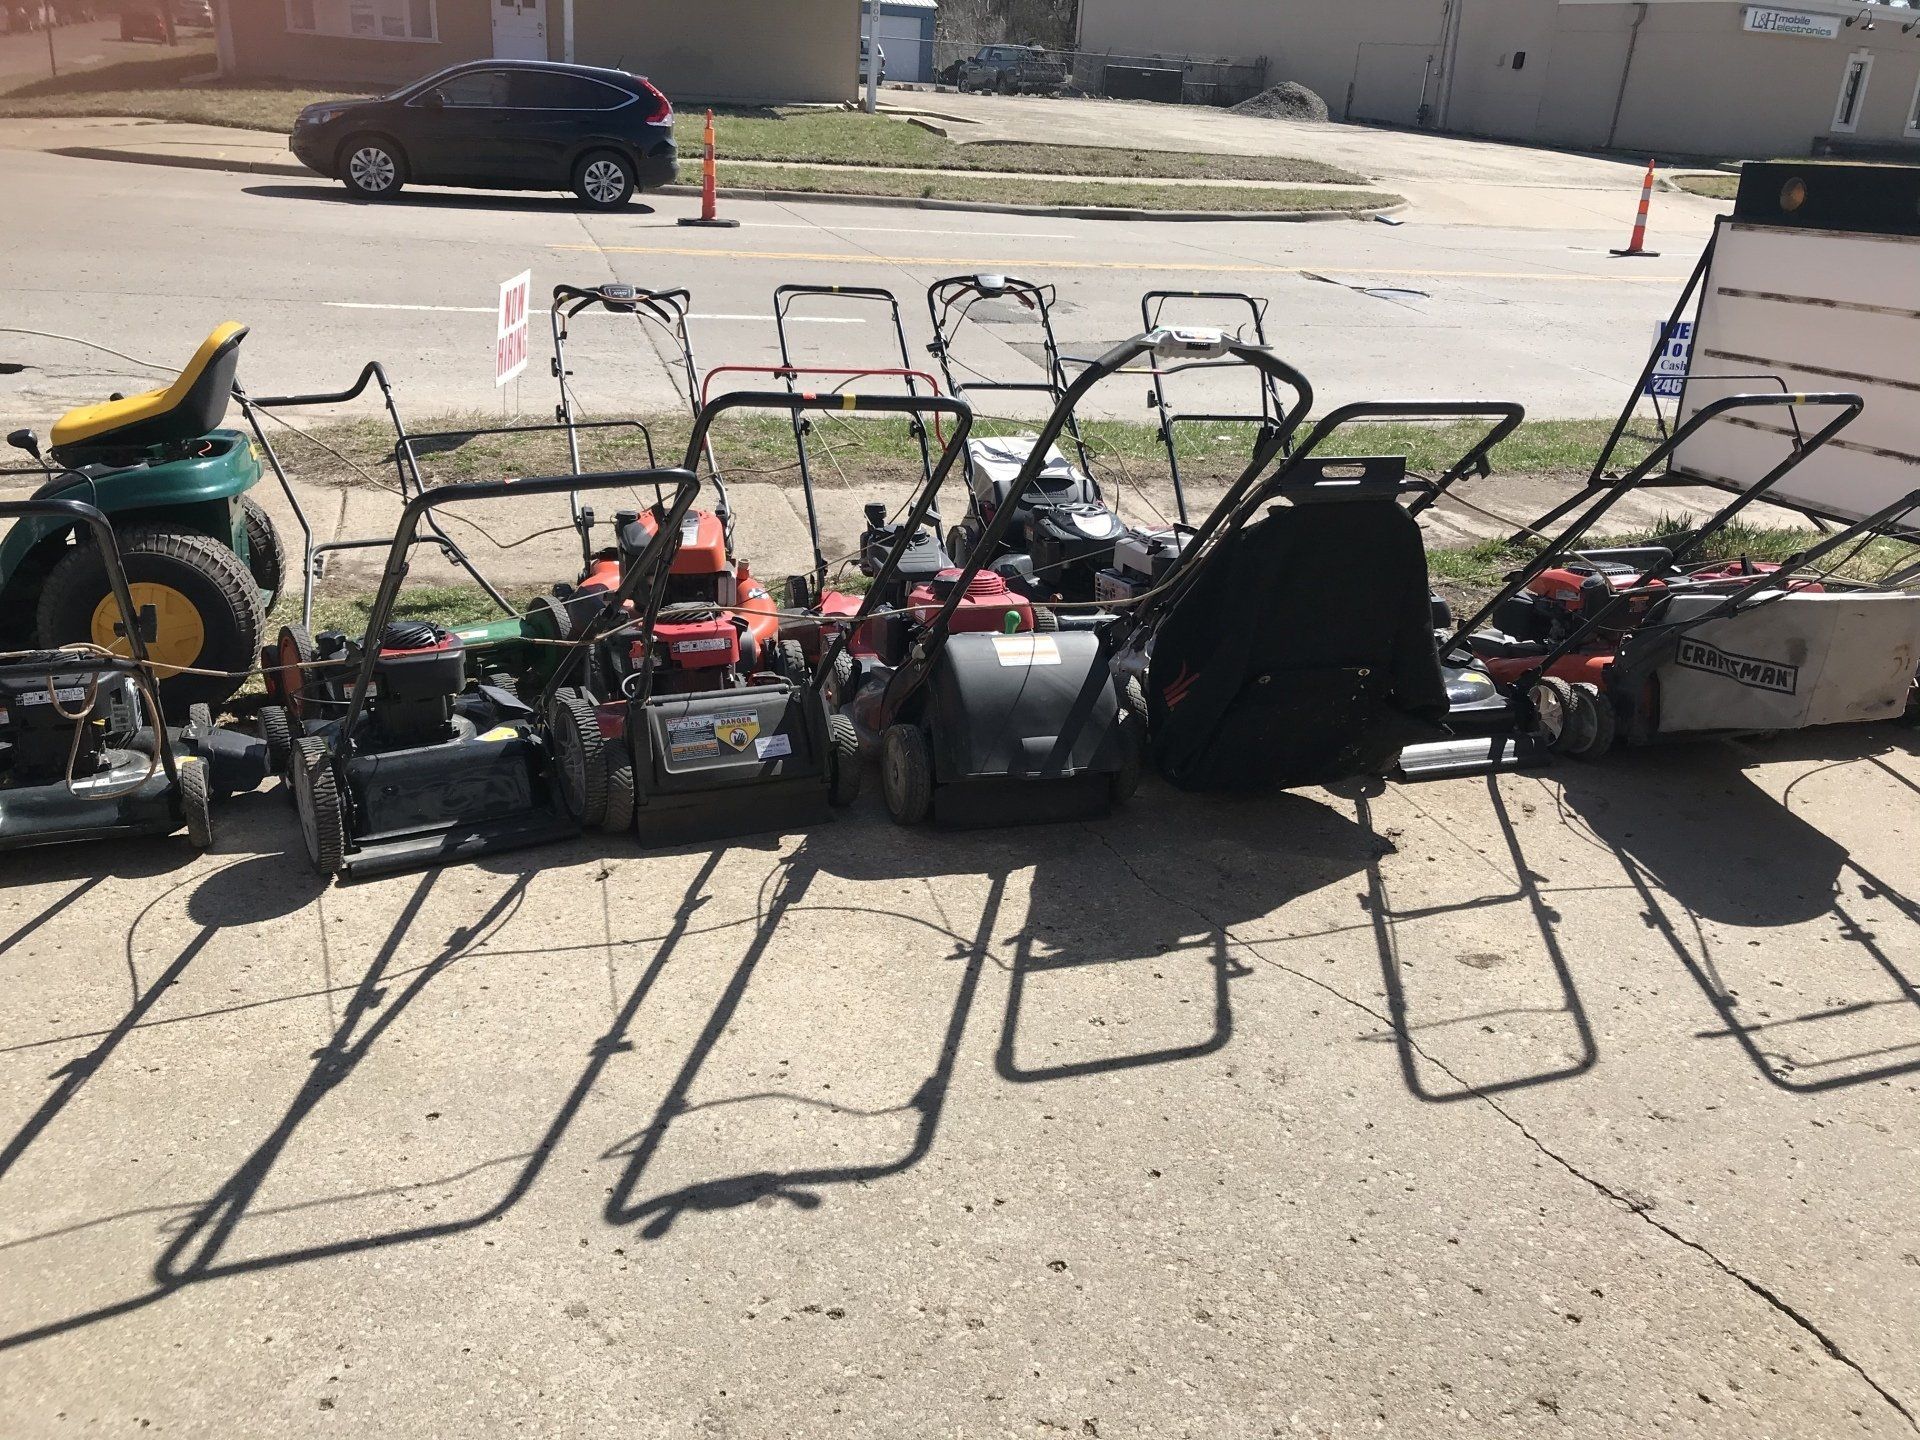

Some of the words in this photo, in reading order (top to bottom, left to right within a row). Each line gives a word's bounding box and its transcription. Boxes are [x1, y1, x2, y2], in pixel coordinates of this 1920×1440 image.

[1752, 11, 1780, 30] L&H
[1778, 15, 1811, 26] mobile
[1776, 24, 1832, 36] electronics
[505, 282, 525, 330] NOW
[497, 322, 527, 378] HIRING
[1682, 645, 1787, 687] CRAFTSMAN
[720, 716, 752, 726] DANGER
